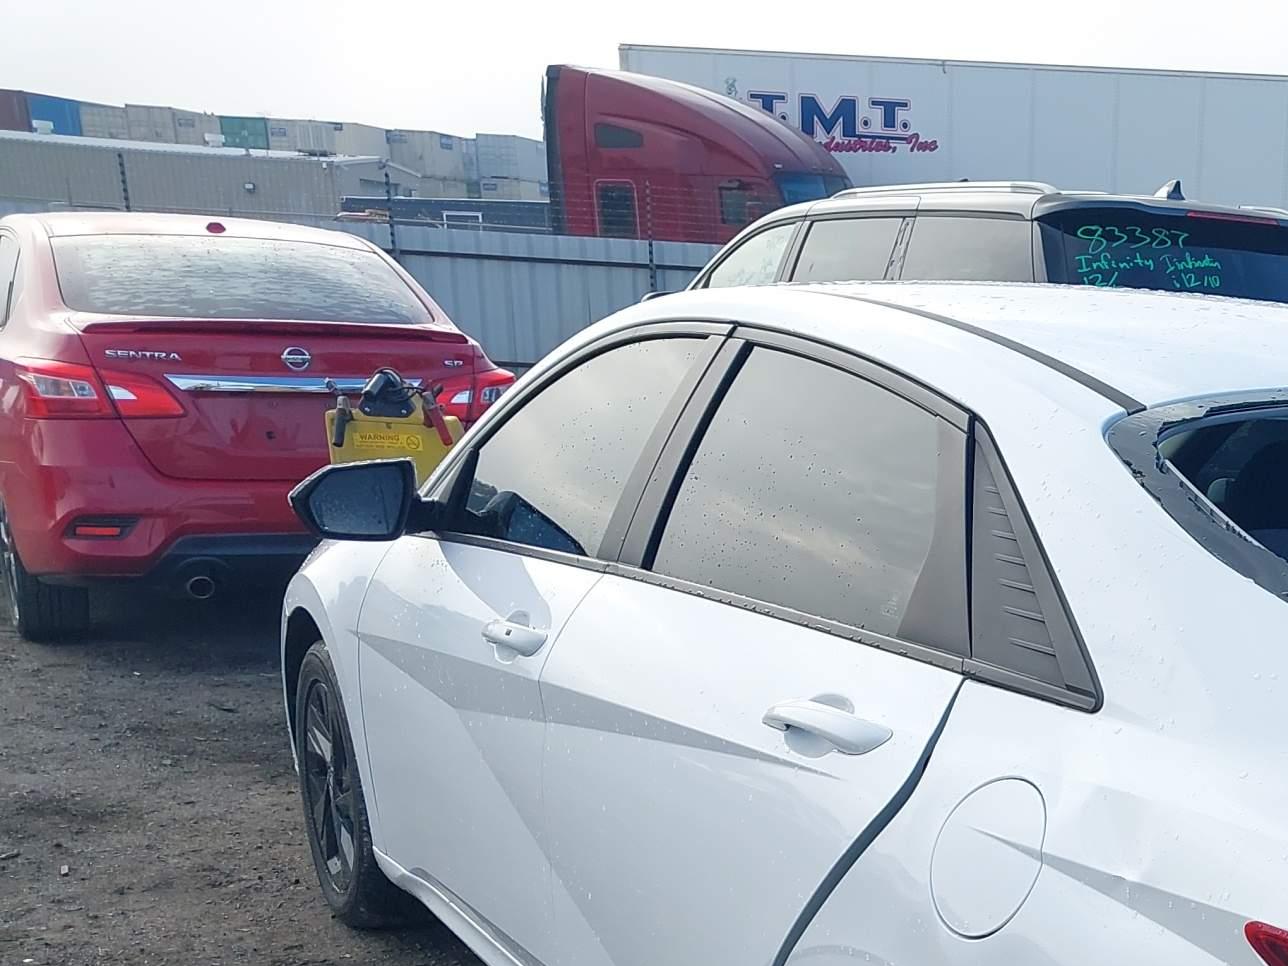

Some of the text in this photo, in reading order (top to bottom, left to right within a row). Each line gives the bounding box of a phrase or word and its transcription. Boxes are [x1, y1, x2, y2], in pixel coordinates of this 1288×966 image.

[819, 132, 939, 153] dustries, Inc
[1076, 225, 1190, 255] 83387
[104, 349, 182, 361] SENTRA
